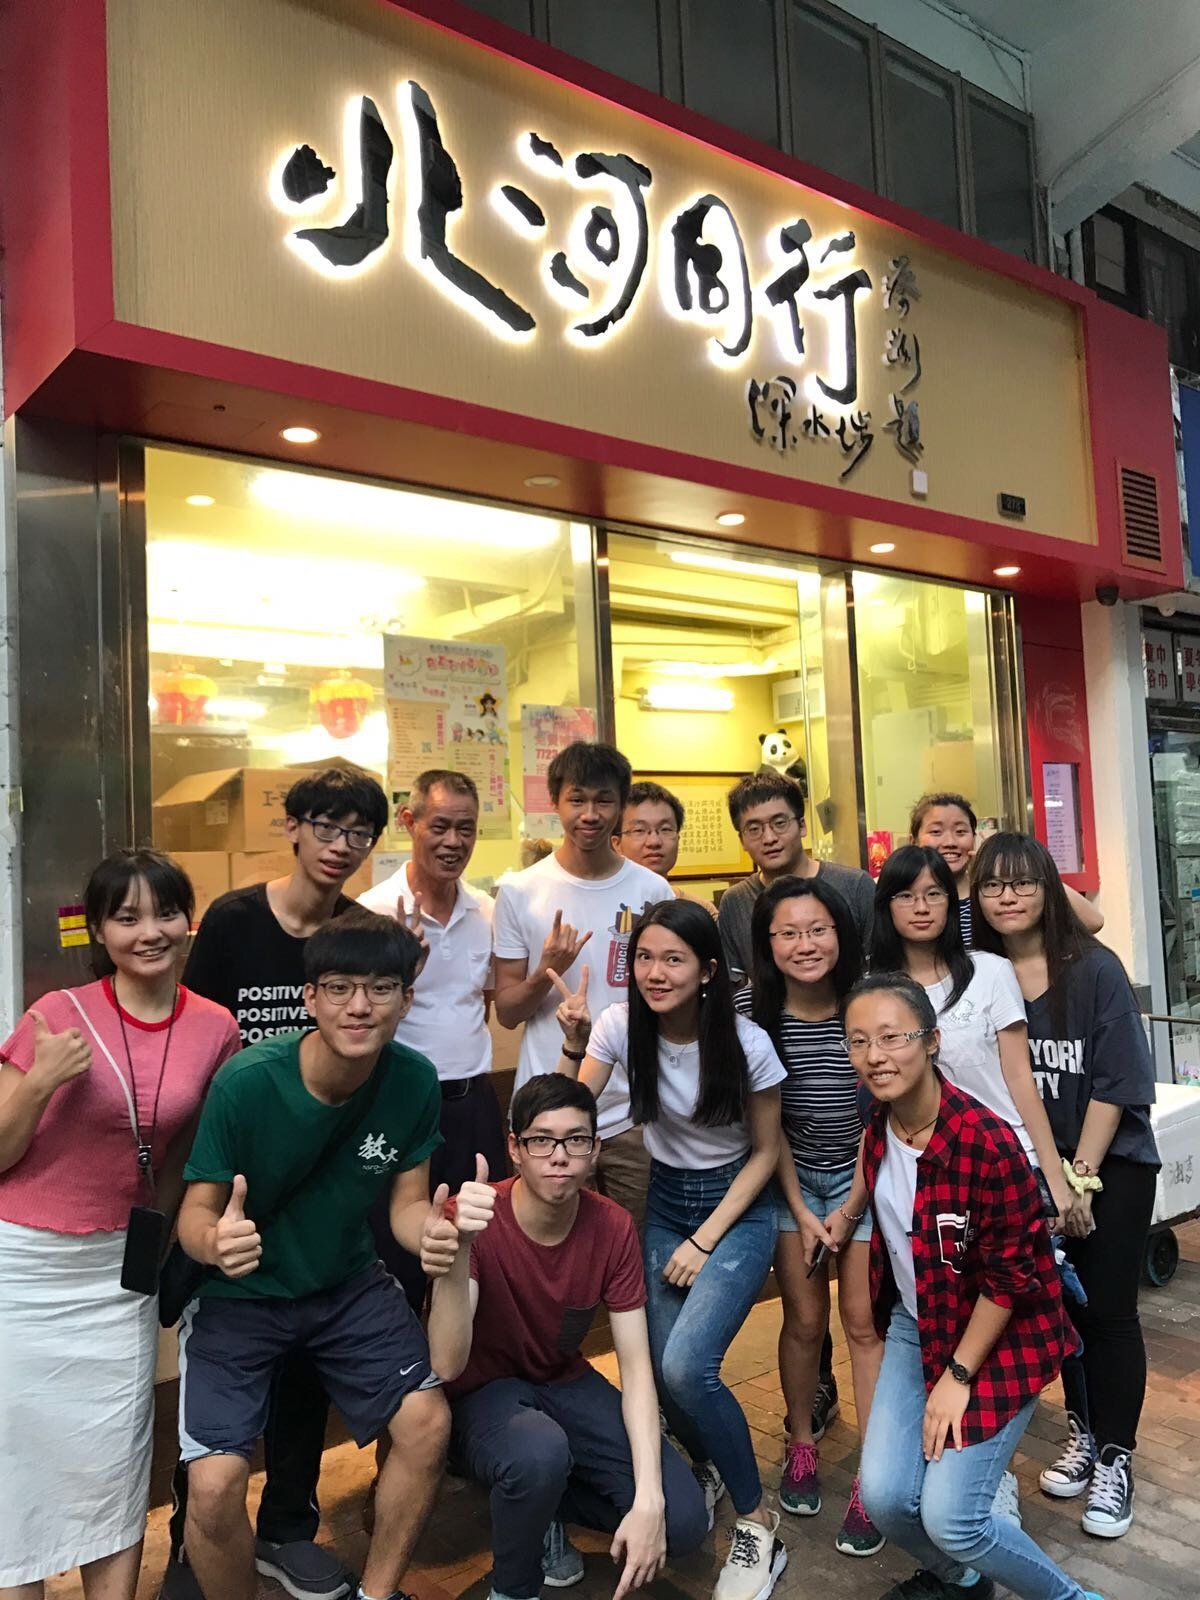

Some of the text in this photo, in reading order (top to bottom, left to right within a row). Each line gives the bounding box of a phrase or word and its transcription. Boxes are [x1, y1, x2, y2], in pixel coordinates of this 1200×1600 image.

[282, 80, 872, 404] 北河同行
[238, 985, 305, 1002] POSITIV
[237, 1006, 308, 1023] POSITIVE
[358, 1132, 398, 1164] 教大
